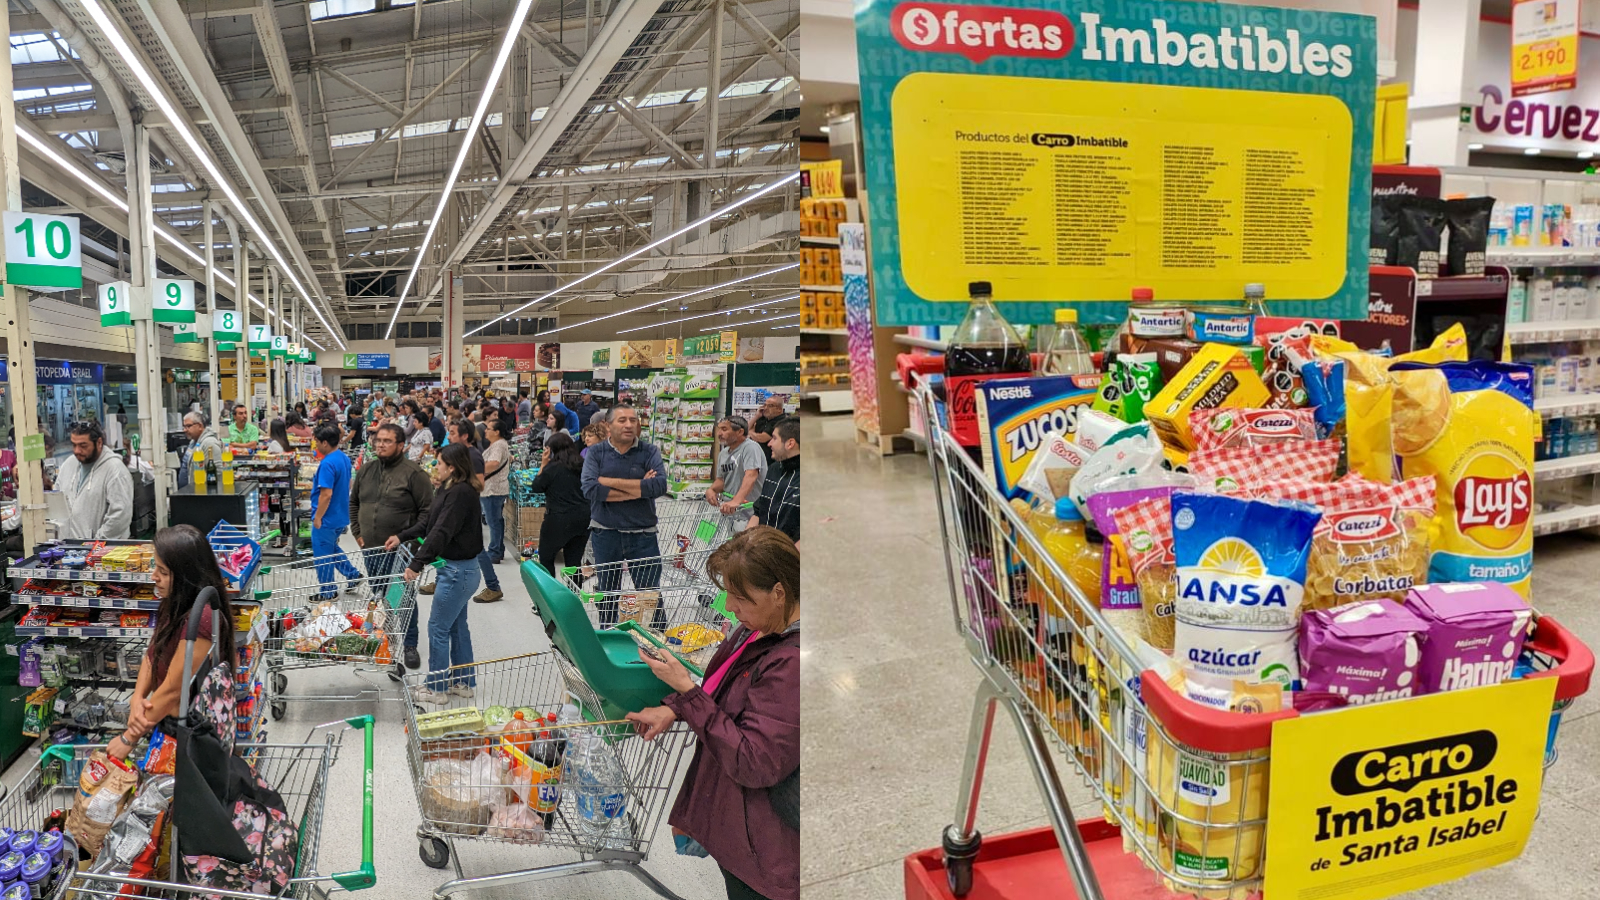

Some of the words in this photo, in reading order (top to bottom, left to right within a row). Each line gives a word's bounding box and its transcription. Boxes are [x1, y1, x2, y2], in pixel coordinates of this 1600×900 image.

[1081, 12, 1352, 77] Imbatibles
[955, 131, 1010, 143] Productos
[1013, 132, 1029, 143] del
[1037, 134, 1069, 146] Carro
[1076, 136, 1128, 148] Imbatible
[14, 218, 73, 260] 10
[107, 286, 117, 309] 9
[165, 283, 182, 306] 9
[223, 313, 234, 330] 8
[1141, 317, 1181, 326] Antartic
[1207, 323, 1247, 333] Antartic
[255, 327, 264, 340] 7
[275, 337, 282, 348] 6
[289, 344, 295, 353] 5
[71, 367, 92, 378] ISRAEL
[488, 359, 530, 371] pasles
[1254, 417, 1293, 428] Carozzi
[1006, 402, 1091, 463] ZUCOS
[1051, 438, 1082, 467] Costa
[1461, 475, 1528, 529] Lay's
[1338, 517, 1381, 532] Carozzi
[1469, 559, 1518, 578] tamaño
[1335, 575, 1413, 594] Corbatas
[1456, 635, 1494, 649] Máxima!
[1189, 648, 1261, 667] azúcar
[1336, 665, 1387, 681] Máxima!
[1440, 655, 1514, 692] Harina
[1355, 743, 1472, 788] Carro
[1315, 775, 1518, 842] Imbatible
[1310, 857, 1331, 871] de
[1340, 834, 1420, 867] Santa
[1427, 811, 1507, 848] Isabel
